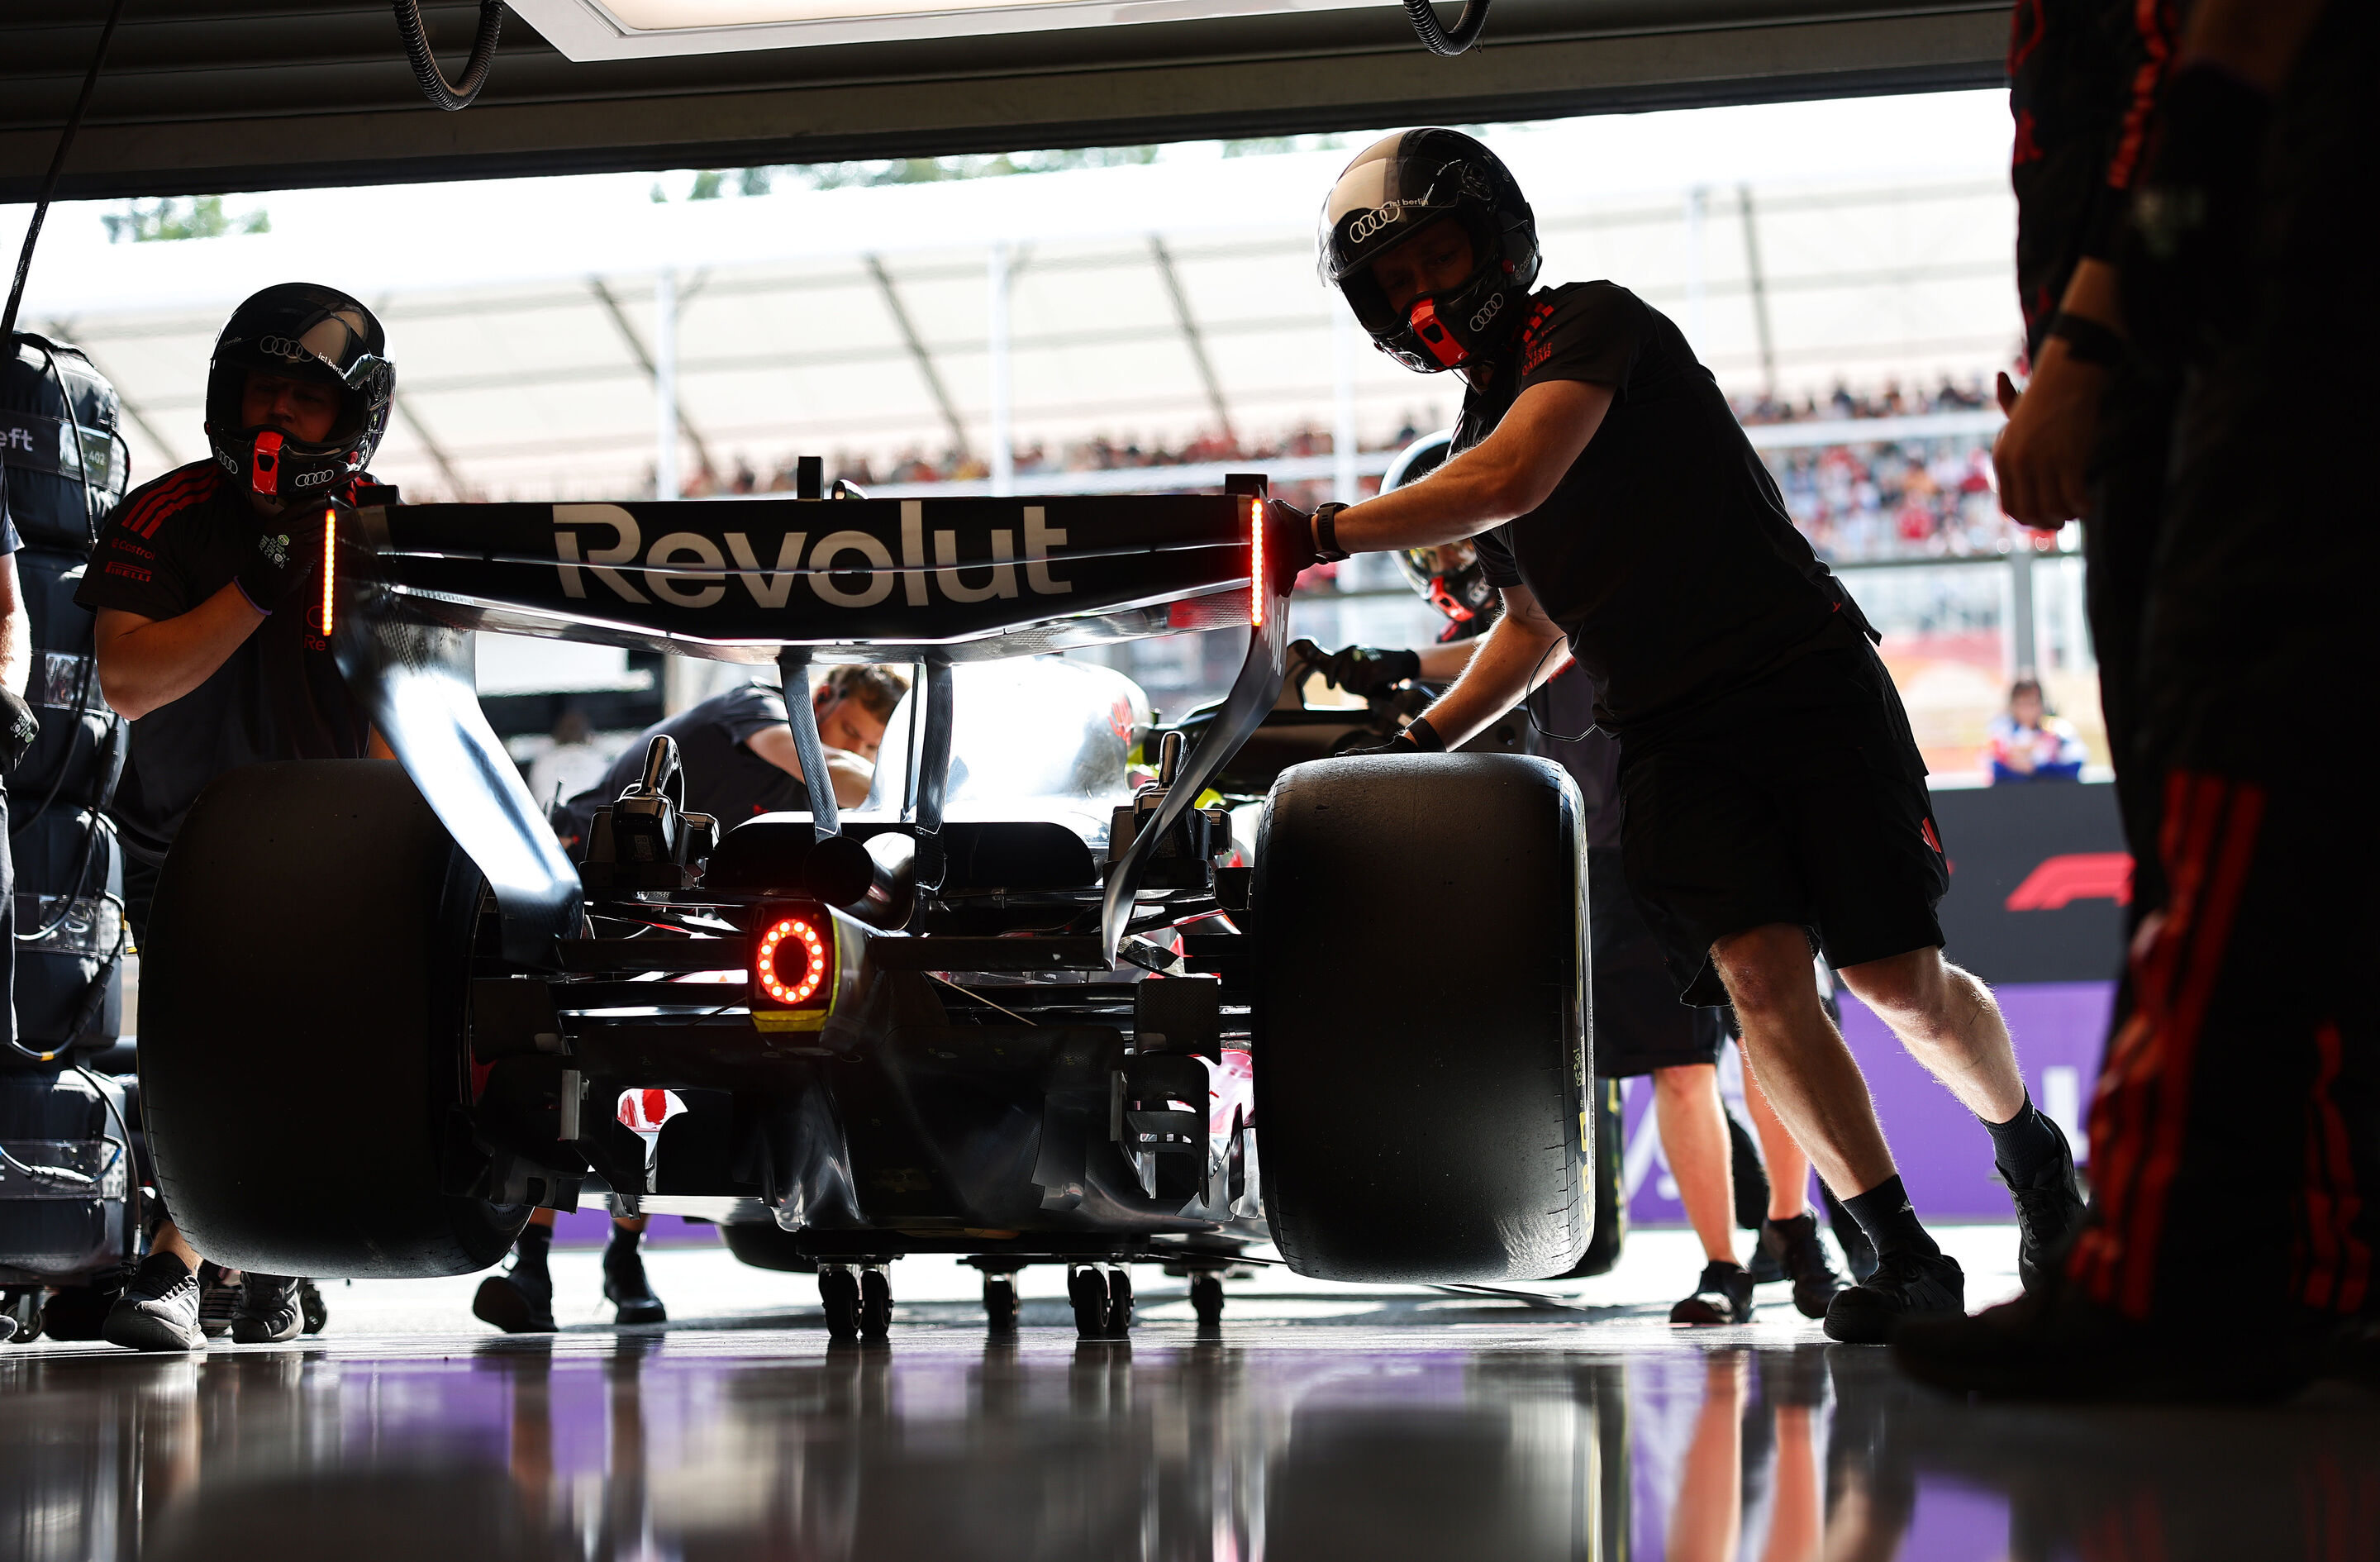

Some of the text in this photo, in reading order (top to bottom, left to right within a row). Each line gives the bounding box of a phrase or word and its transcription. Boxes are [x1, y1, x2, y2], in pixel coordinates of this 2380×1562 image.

[327, 359, 346, 380] berlin
[1521, 350, 1552, 376] QATAR
[552, 499, 1073, 609] Revolut
[106, 561, 153, 583] PIRELLI
